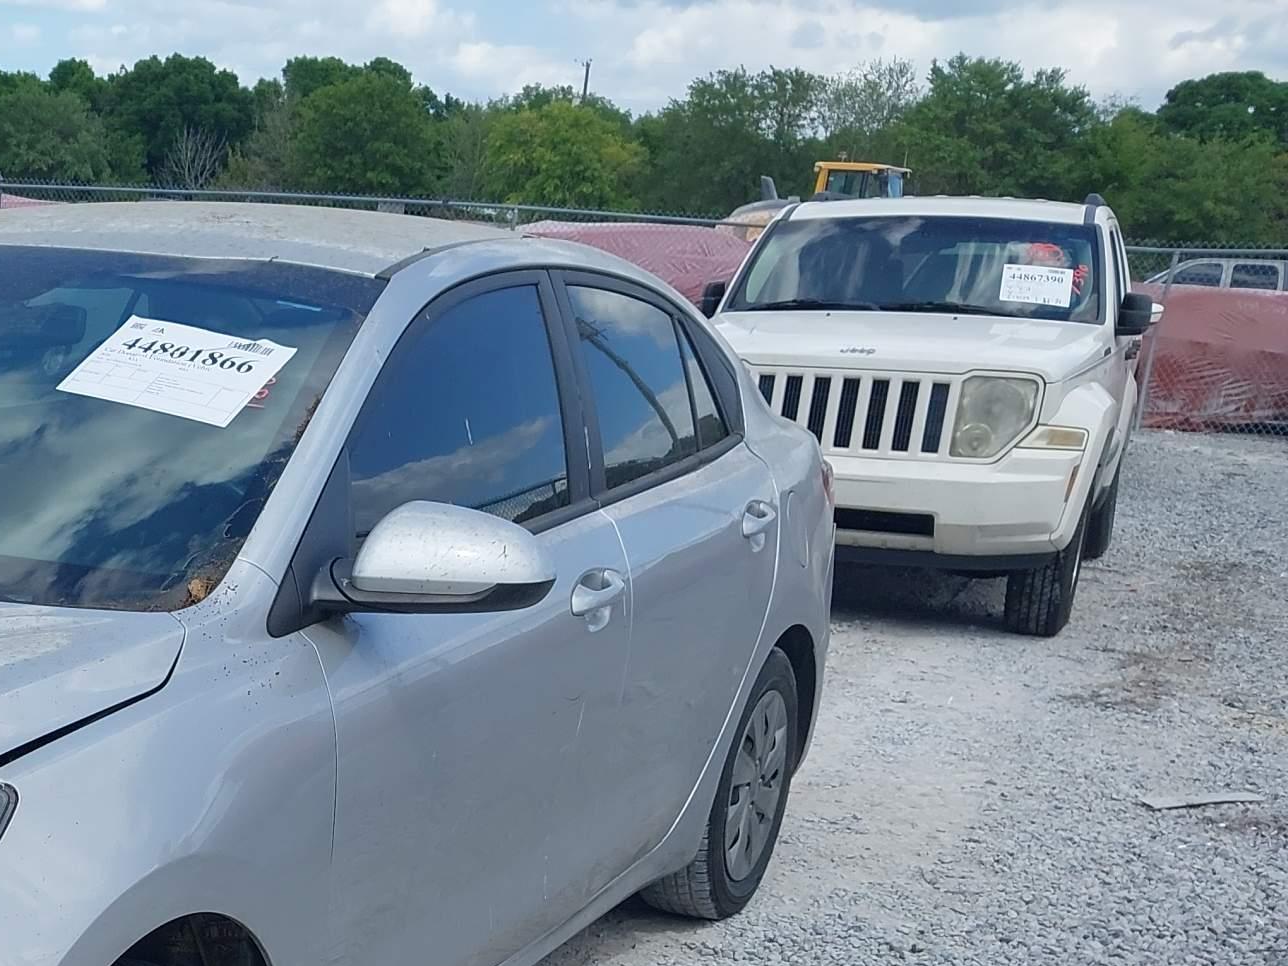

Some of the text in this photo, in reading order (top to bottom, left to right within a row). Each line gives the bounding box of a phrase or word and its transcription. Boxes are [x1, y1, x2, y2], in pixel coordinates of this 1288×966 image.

[1009, 272, 1064, 284] 44867390
[121, 336, 257, 374] 44801866
[839, 346, 877, 356] Jeep
